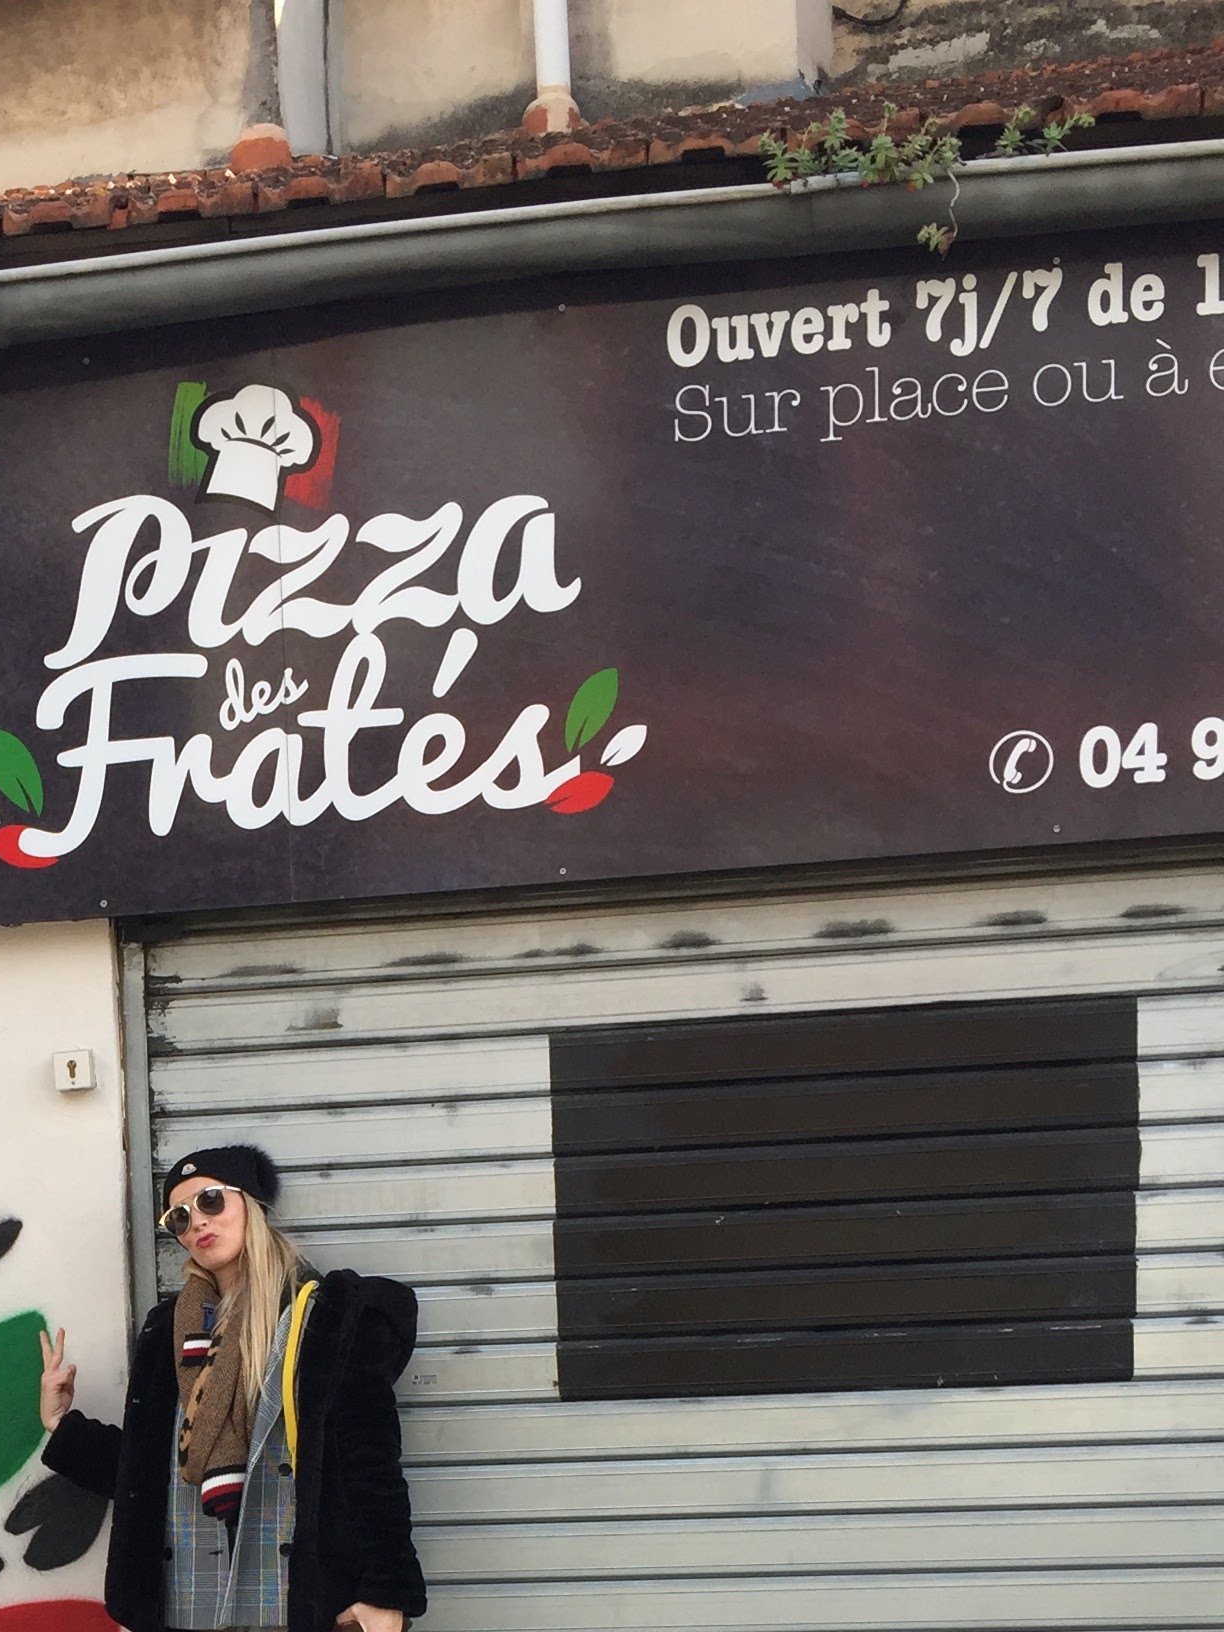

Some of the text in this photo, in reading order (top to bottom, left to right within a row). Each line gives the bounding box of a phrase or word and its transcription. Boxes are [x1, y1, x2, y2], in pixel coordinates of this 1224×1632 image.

[666, 288, 892, 368] Ouvert
[915, 268, 1063, 357] 7j/7
[1087, 262, 1165, 327] de
[674, 384, 801, 442] Sur
[819, 366, 1009, 443] place
[1032, 358, 1125, 407] ou
[1145, 338, 1189, 397] à
[44, 494, 581, 669] Pizza
[18, 627, 581, 858] Fratés
[219, 657, 309, 731] des
[1079, 722, 1168, 789] 04
